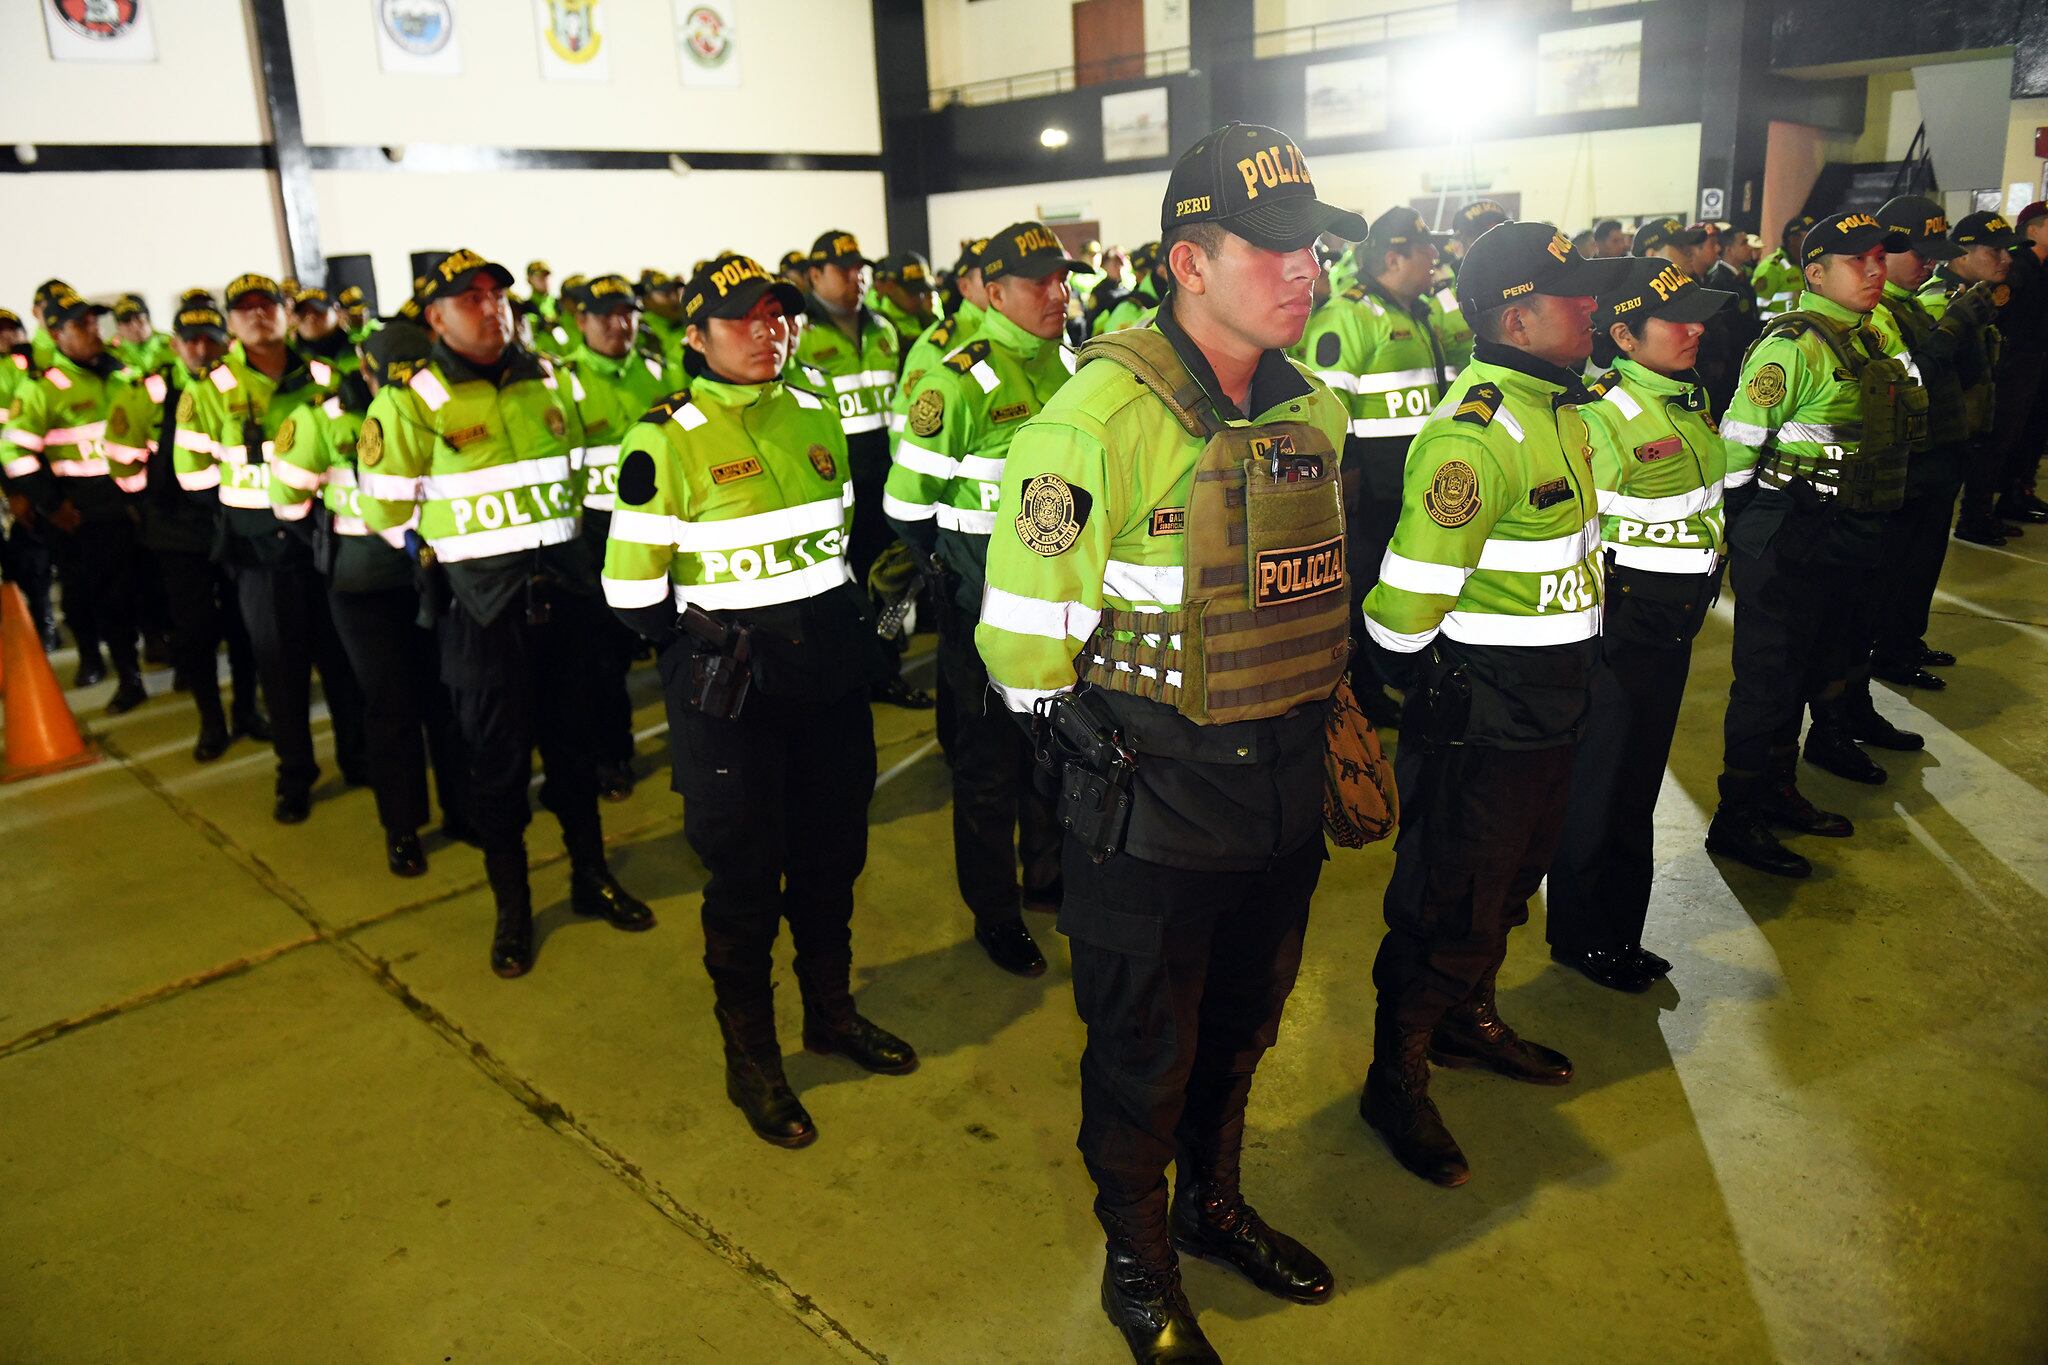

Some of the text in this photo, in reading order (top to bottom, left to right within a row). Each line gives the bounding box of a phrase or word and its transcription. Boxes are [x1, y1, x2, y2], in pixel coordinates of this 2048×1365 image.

[1176, 195, 1212, 218] PERU
[1808, 245, 1824, 259] PERU
[1503, 281, 1535, 299] PERU
[1613, 296, 1643, 316] PERU
[1436, 463, 1455, 480] POLICIA
[1026, 476, 1072, 506] POLICIA NACIONAL
[1260, 549, 1342, 597] POLICIA
